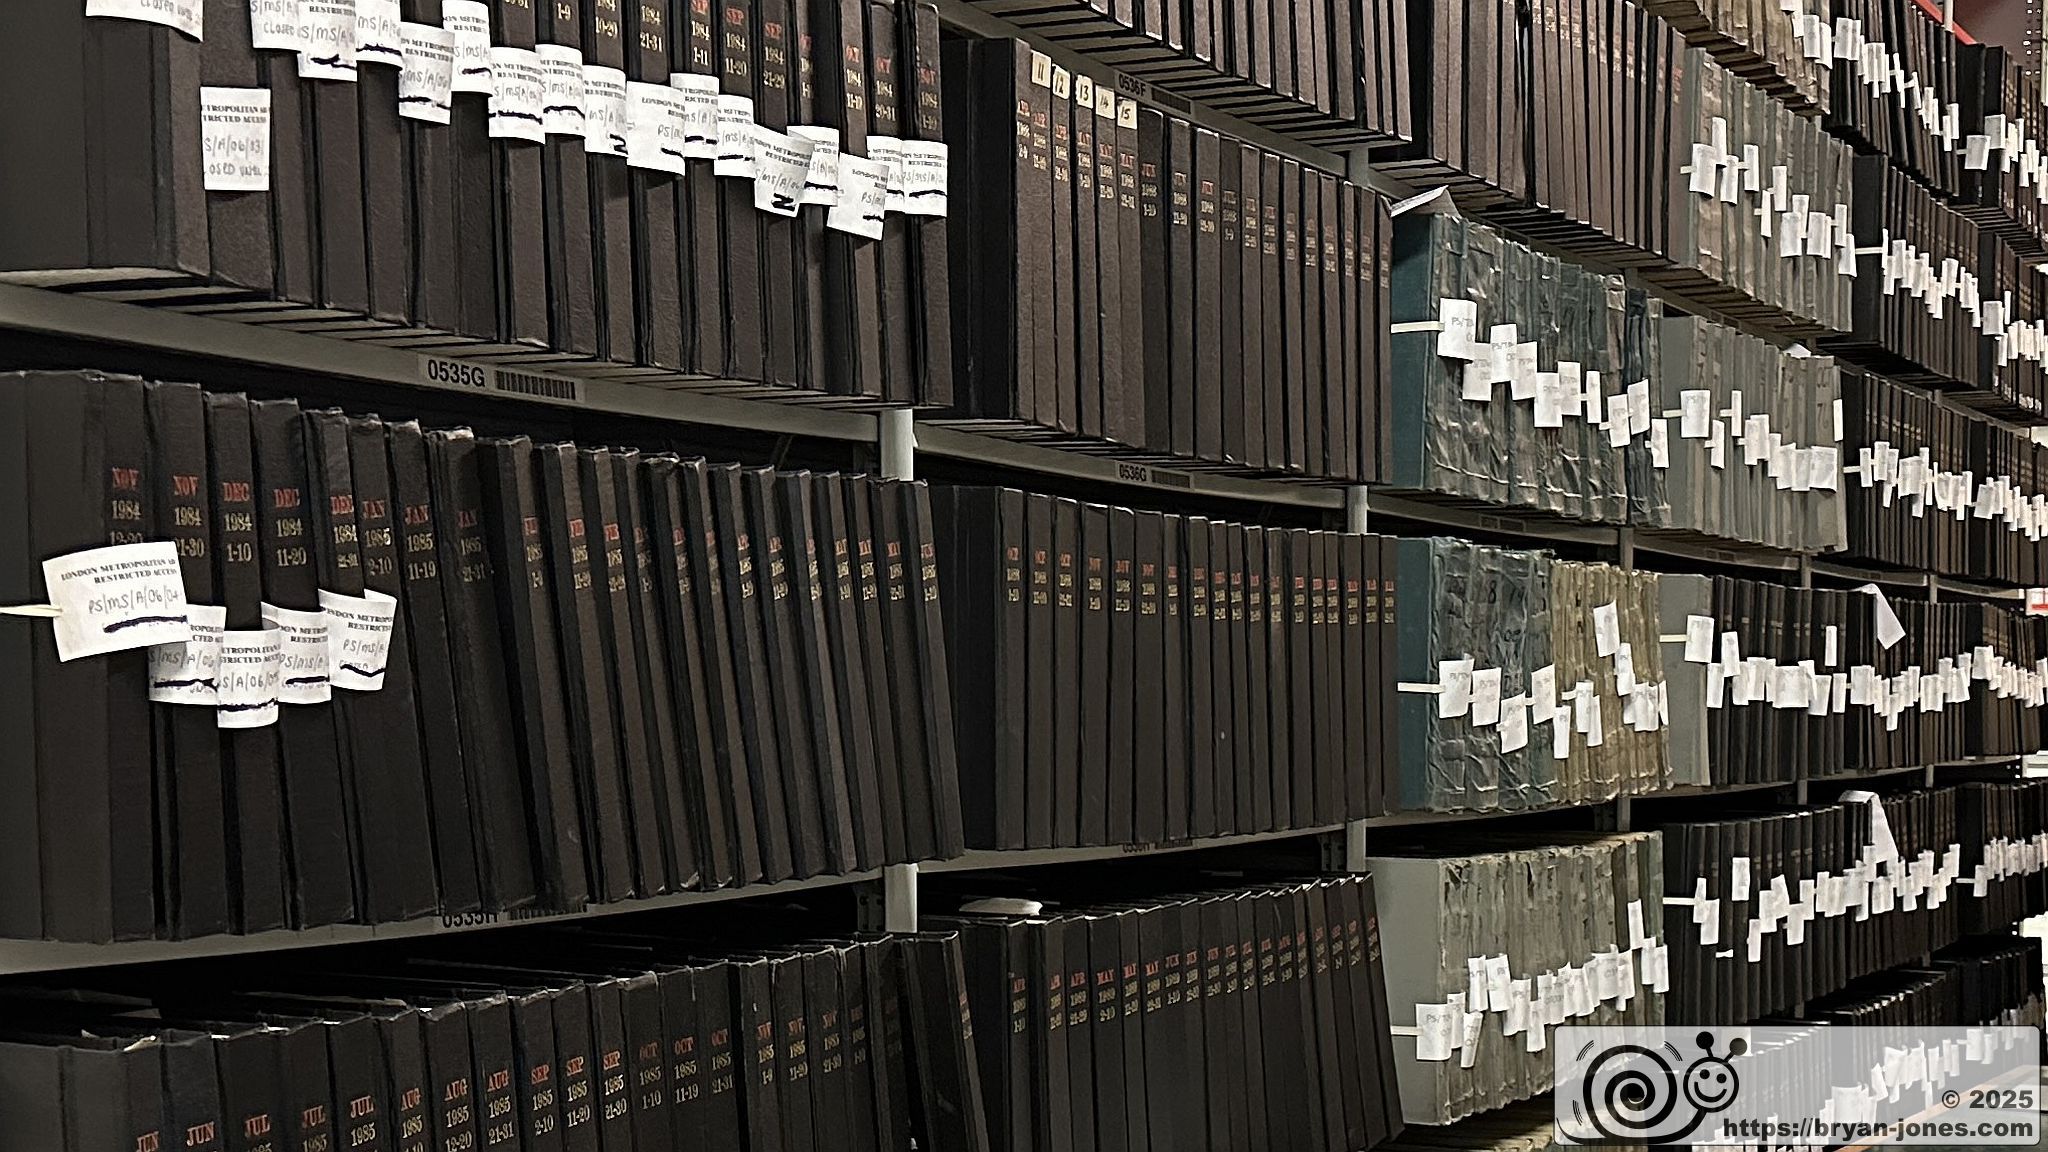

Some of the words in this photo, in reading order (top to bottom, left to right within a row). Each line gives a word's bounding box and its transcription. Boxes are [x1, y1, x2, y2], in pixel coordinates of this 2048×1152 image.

[557, 3, 571, 20] 1-9
[641, 5, 660, 25] 1984
[691, 20, 710, 40] 1984
[639, 32, 662, 52] 21-31
[726, 33, 746, 51] 1984
[765, 46, 784, 65] 1984
[726, 59, 747, 76] 11-20
[1037, 61, 1045, 82] 11
[876, 80, 893, 98] 1984
[1054, 75, 1064, 95] 12
[1079, 82, 1089, 101] 13
[1118, 73, 1147, 97] 0536F
[1100, 95, 1109, 110] 14
[1120, 105, 1131, 121] 15
[428, 359, 486, 388] 0535G
[112, 467, 139, 489] NOV
[1119, 463, 1147, 482] 0536G
[173, 474, 199, 496] NOV
[223, 482, 250, 502] DEC
[274, 488, 300, 507] DEC
[112, 501, 141, 521] 1984
[174, 507, 202, 527] 1984
[362, 500, 385, 519] JAN
[404, 504, 429, 524] JAN
[224, 513, 252, 532] 1984
[276, 518, 303, 537] 1984
[334, 524, 358, 544] 1984
[365, 528, 391, 547] 1985
[407, 533, 433, 552] 1985
[227, 543, 252, 562] 1-10
[276, 548, 307, 567] 11-20
[61, 568, 97, 581] LONDON
[100, 560, 166, 573] METROPOLITAN
[368, 556, 393, 576] 2-10
[408, 561, 437, 580] 11-19
[94, 570, 151, 584] RESTRICTED
[674, 1036, 694, 1055] OCT
[711, 1028, 728, 1047] OCT
[603, 1051, 621, 1070] SEP
[640, 1042, 658, 1060] OCT
[566, 1056, 584, 1077] SEP
[674, 1060, 697, 1080] 1985
[711, 1052, 731, 1071] 1985
[487, 1070, 509, 1092] AUG
[531, 1064, 549, 1085] SEP
[640, 1066, 661, 1086] 1985
[711, 1074, 733, 1094] 21-31
[444, 1078, 468, 1101] AUG
[567, 1080, 588, 1102] 1985
[604, 1074, 624, 1096] 1985
[675, 1083, 699, 1104] 11-19
[350, 1095, 374, 1118] JUL
[401, 1088, 421, 1111] AUG
[489, 1096, 511, 1118] 1985
[533, 1089, 553, 1111] 1985
[605, 1098, 627, 1120] 21-30
[642, 1090, 662, 1110] 1-10
[245, 1114, 271, 1138] JUL
[302, 1105, 326, 1128] JUL
[446, 1105, 469, 1128] 1985
[535, 1115, 554, 1136] 2-10
[567, 1105, 590, 1128] 11-20
[187, 1121, 215, 1147] JUN
[351, 1122, 376, 1147] 1985
[402, 1115, 423, 1139] 1985
[488, 1121, 514, 1145] 21-31
[136, 1131, 159, 1152] JUN
